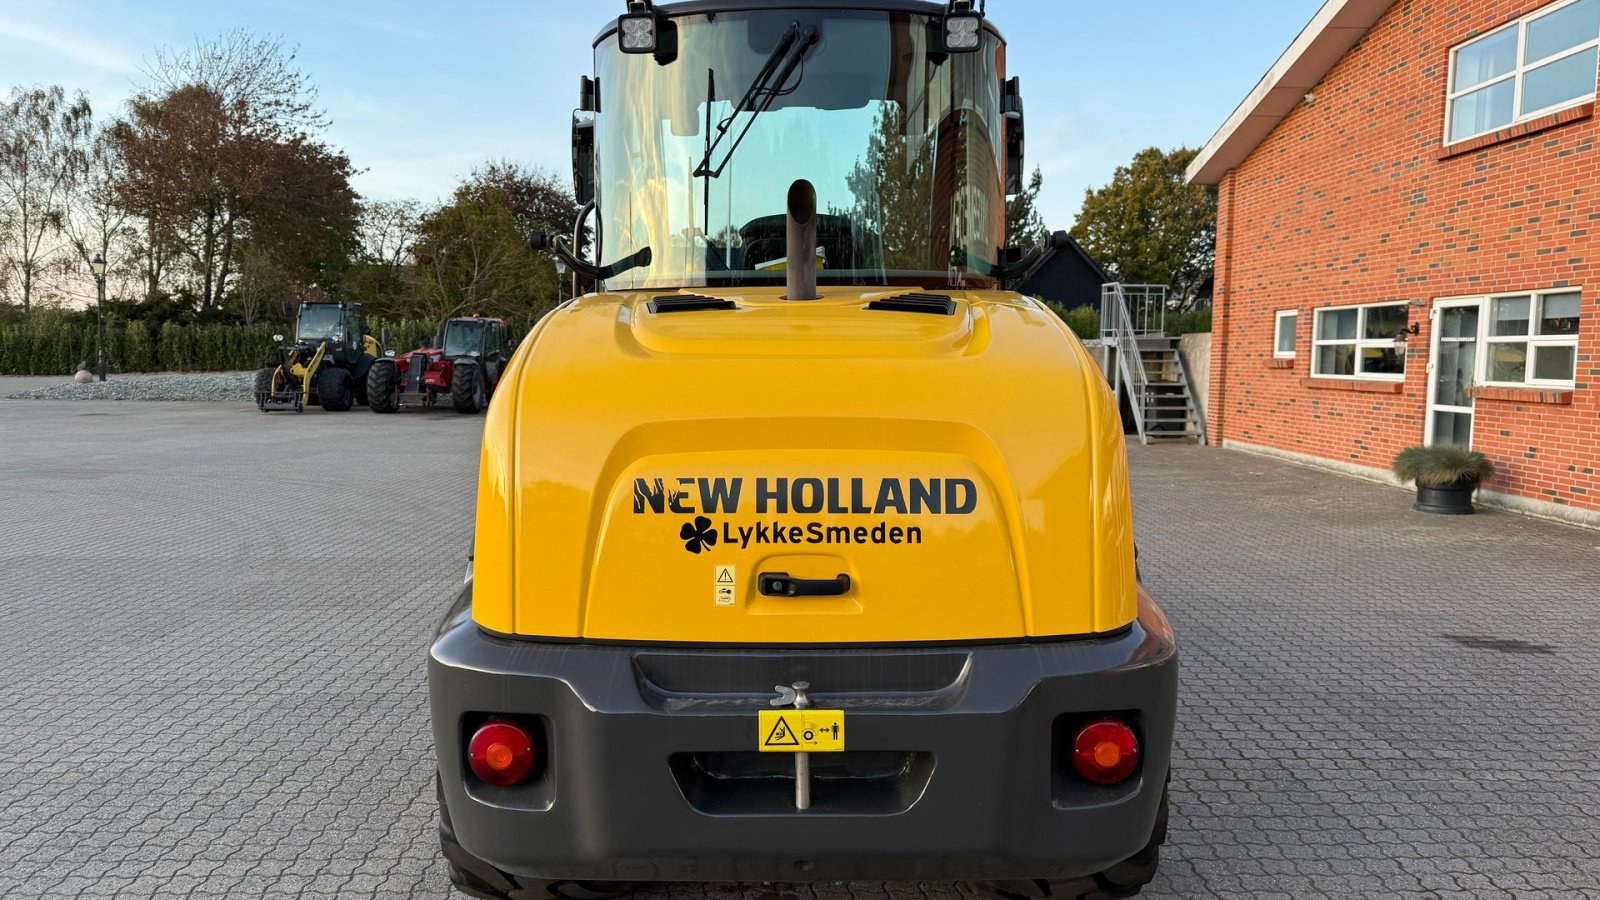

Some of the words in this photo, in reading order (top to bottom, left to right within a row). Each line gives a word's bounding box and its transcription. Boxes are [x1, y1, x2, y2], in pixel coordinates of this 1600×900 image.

[633, 478, 743, 514] NEW
[755, 477, 977, 514] HOLLAND
[723, 521, 922, 549] LykkeSmeden
